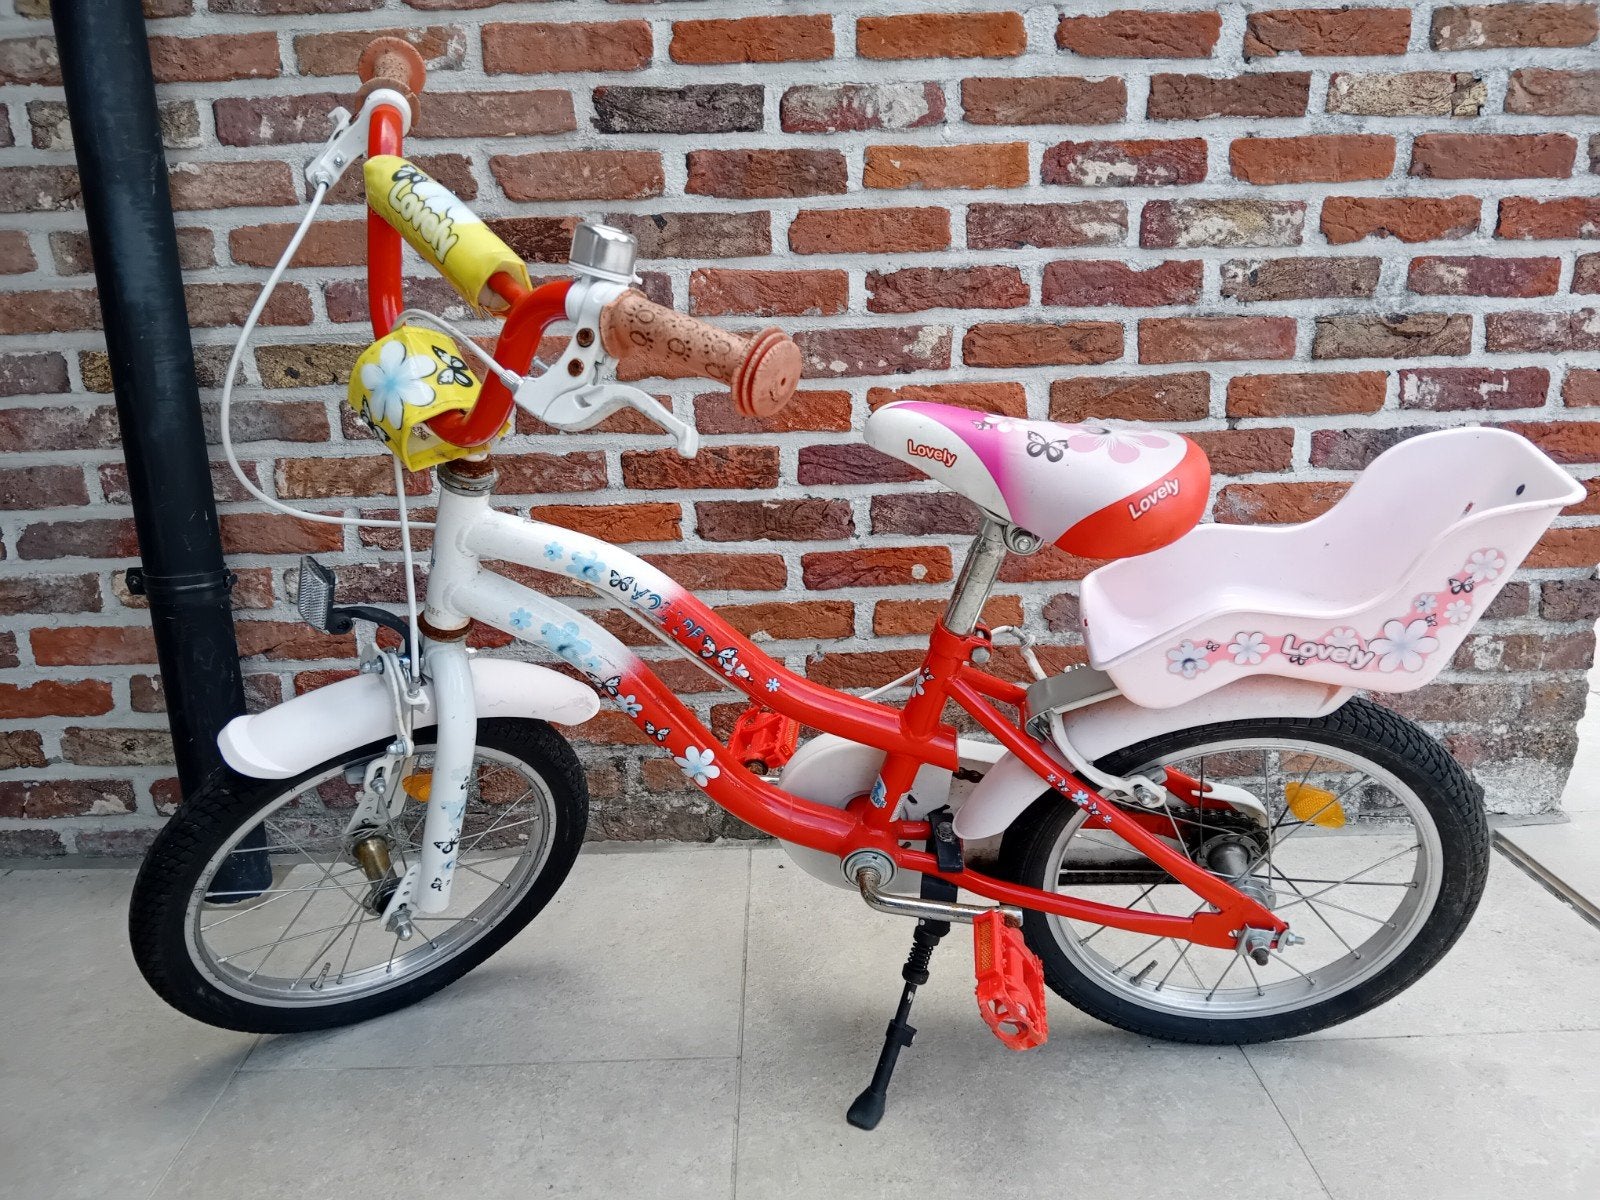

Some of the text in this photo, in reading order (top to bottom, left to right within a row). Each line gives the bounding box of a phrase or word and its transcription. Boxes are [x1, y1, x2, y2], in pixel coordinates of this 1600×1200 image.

[388, 178, 459, 265] Lovely
[907, 438, 957, 467] Lovely
[1127, 478, 1180, 521] Lovely
[1281, 634, 1375, 670] Lovely
